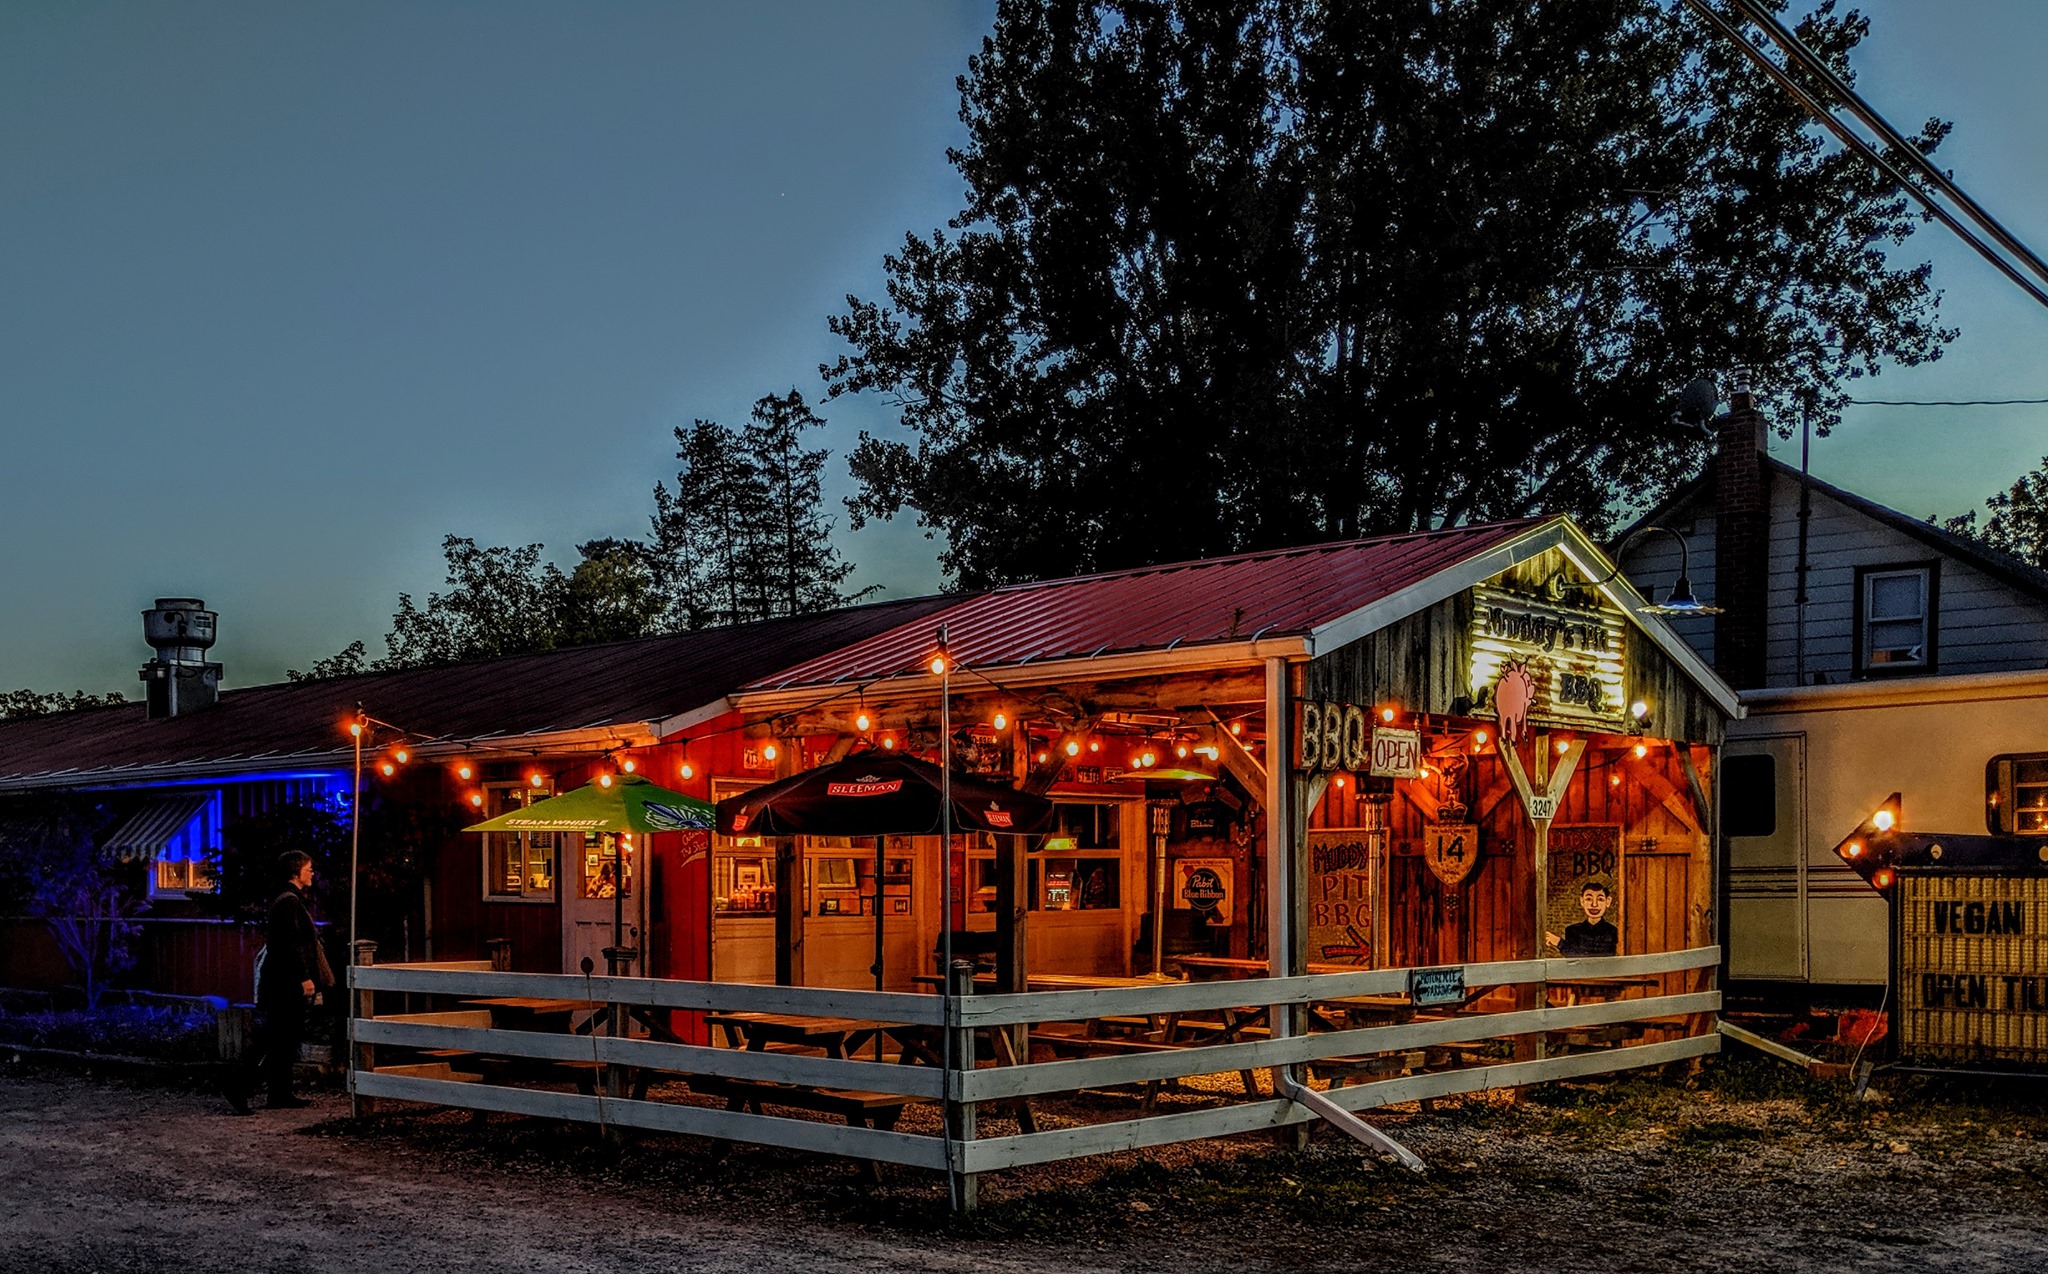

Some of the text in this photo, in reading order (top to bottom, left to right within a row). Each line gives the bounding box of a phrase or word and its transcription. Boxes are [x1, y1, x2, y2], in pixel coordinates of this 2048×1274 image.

[1485, 606, 1575, 652] Muddy's
[1559, 672, 1602, 713] BBQ
[1301, 700, 1369, 772] BBQ
[1375, 739, 1418, 770] OPEN
[831, 783, 897, 794] SLEEMAN
[1532, 799, 1551, 817] 3247
[505, 818, 609, 827] STEAM WHISTLE
[1437, 836, 1465, 863] 14
[1572, 849, 1616, 878] BBQ
[1184, 888, 1224, 899] Blue Ribbon
[1192, 874, 1215, 888] Pabst
[1321, 874, 1369, 901] PIT
[1933, 900, 2021, 934] VEGAN
[1922, 973, 1987, 1008] OPEN
